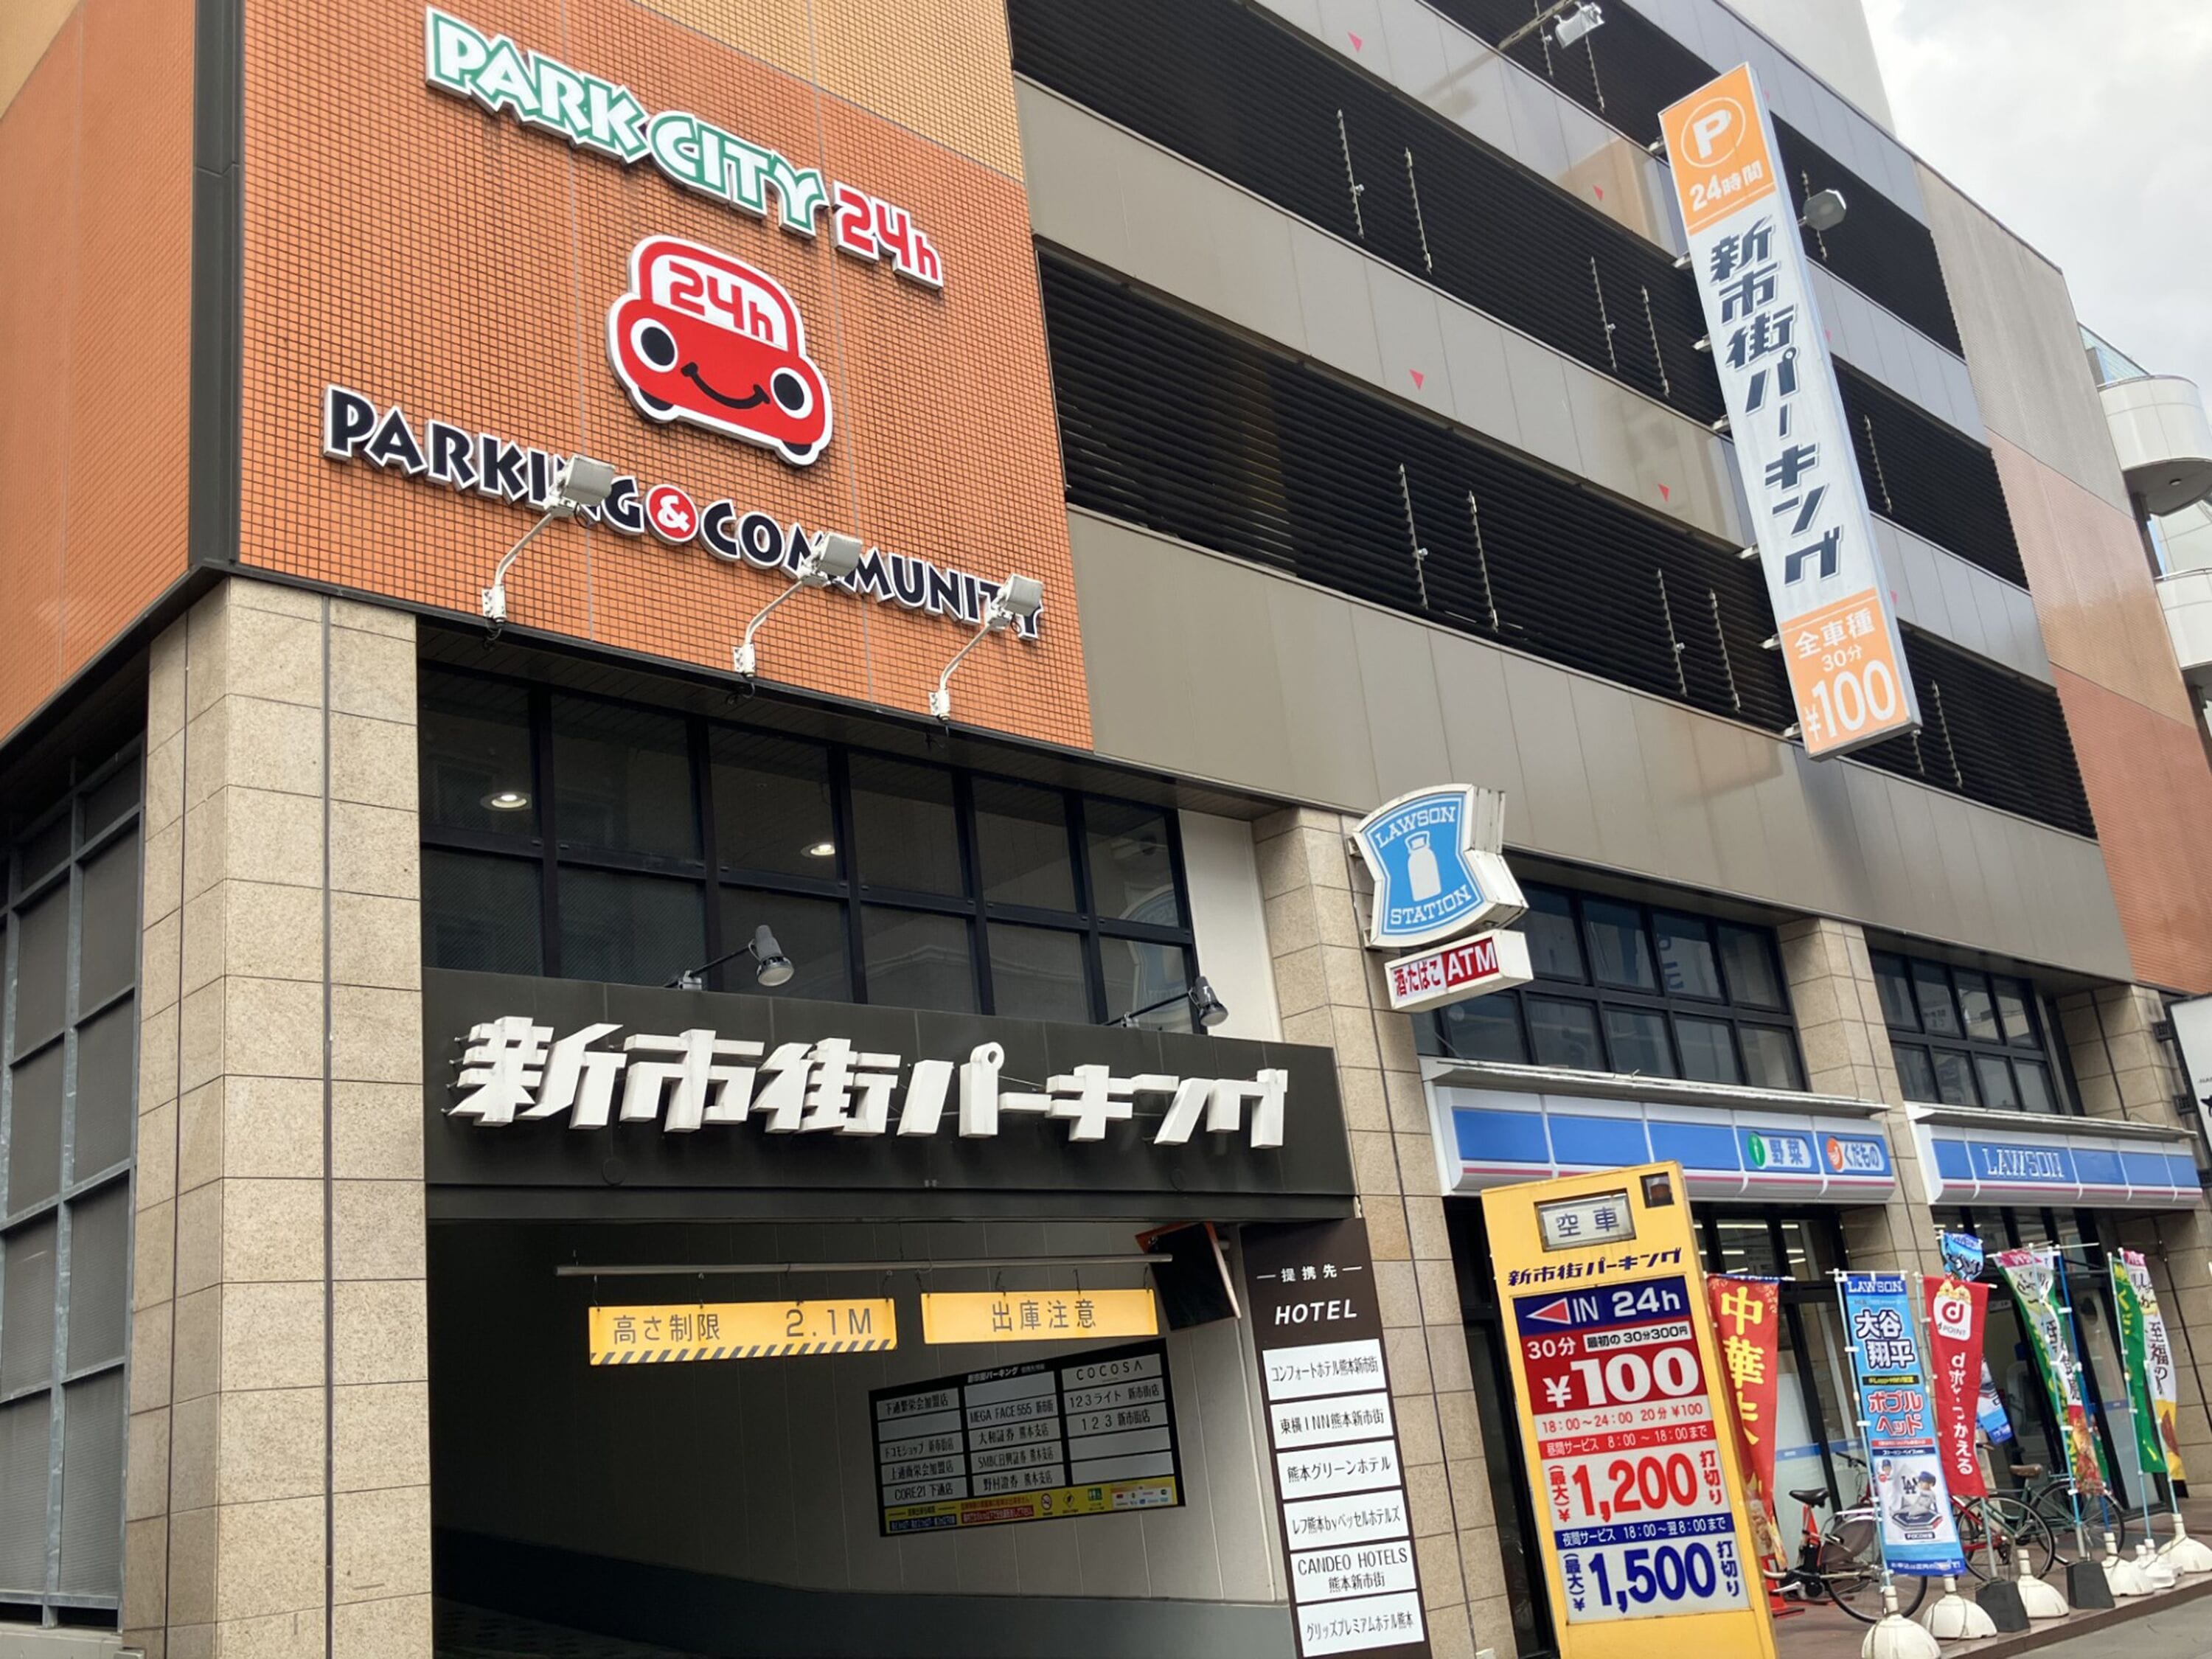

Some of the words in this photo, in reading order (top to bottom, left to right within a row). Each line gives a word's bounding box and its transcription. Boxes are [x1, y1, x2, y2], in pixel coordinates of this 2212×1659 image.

[426, 7, 648, 163] PARK
[647, 111, 827, 237] CITY
[834, 183, 942, 287] 24h
[1693, 109, 1731, 159] P
[1690, 161, 1763, 212] 24時間
[669, 265, 773, 342] 24h
[1709, 215, 1842, 585] 新市街パーキング
[324, 385, 644, 533] PARKIG
[1794, 608, 1876, 659] 全車種
[1821, 644, 1863, 672] 30分
[1374, 806, 1456, 848] LAWSON
[1391, 885, 1472, 925] STATION
[1447, 942, 1497, 981] ATM
[445, 1016, 1289, 1149] 新市街パーキング
[1769, 1138, 1804, 1164] 野菜
[1844, 1144, 1879, 1168] くだもの
[1982, 1148, 2064, 1178] LAWSON
[1555, 1206, 1619, 1238] 空車
[1281, 1264, 1338, 1283] 提携先
[1508, 1248, 1681, 1287] 新市街パーキング
[1847, 1281, 1904, 1293] LAWSON
[991, 1299, 1096, 1332] 出庫注意
[1275, 1298, 1357, 1325] HOTEL
[1573, 1295, 1599, 1324] IN
[1612, 1287, 1680, 1318] 24h
[612, 1312, 721, 1344] 高さ制限
[786, 1307, 872, 1338] 2.1M
[1854, 1309, 1902, 1340] 大谷
[1527, 1335, 1576, 1360] 30分
[1865, 1339, 1916, 1369] 翔平
[1077, 1360, 1143, 1380] COCOSA
[1270, 1355, 1379, 1382] コンフォートホテル熊本新市街
[1542, 1346, 1700, 1409] ¥100
[1287, 1455, 1391, 1484] 熊本グリーンホテル
[1700, 1450, 1722, 1505] 打切り
[894, 1484, 926, 1501] CORE21
[1298, 1554, 1352, 1576] CANDEO
[1357, 1547, 1408, 1568] HOTELS
[1717, 1540, 1739, 1597] 打切り
[1328, 1571, 1385, 1593] 熊本新市街
